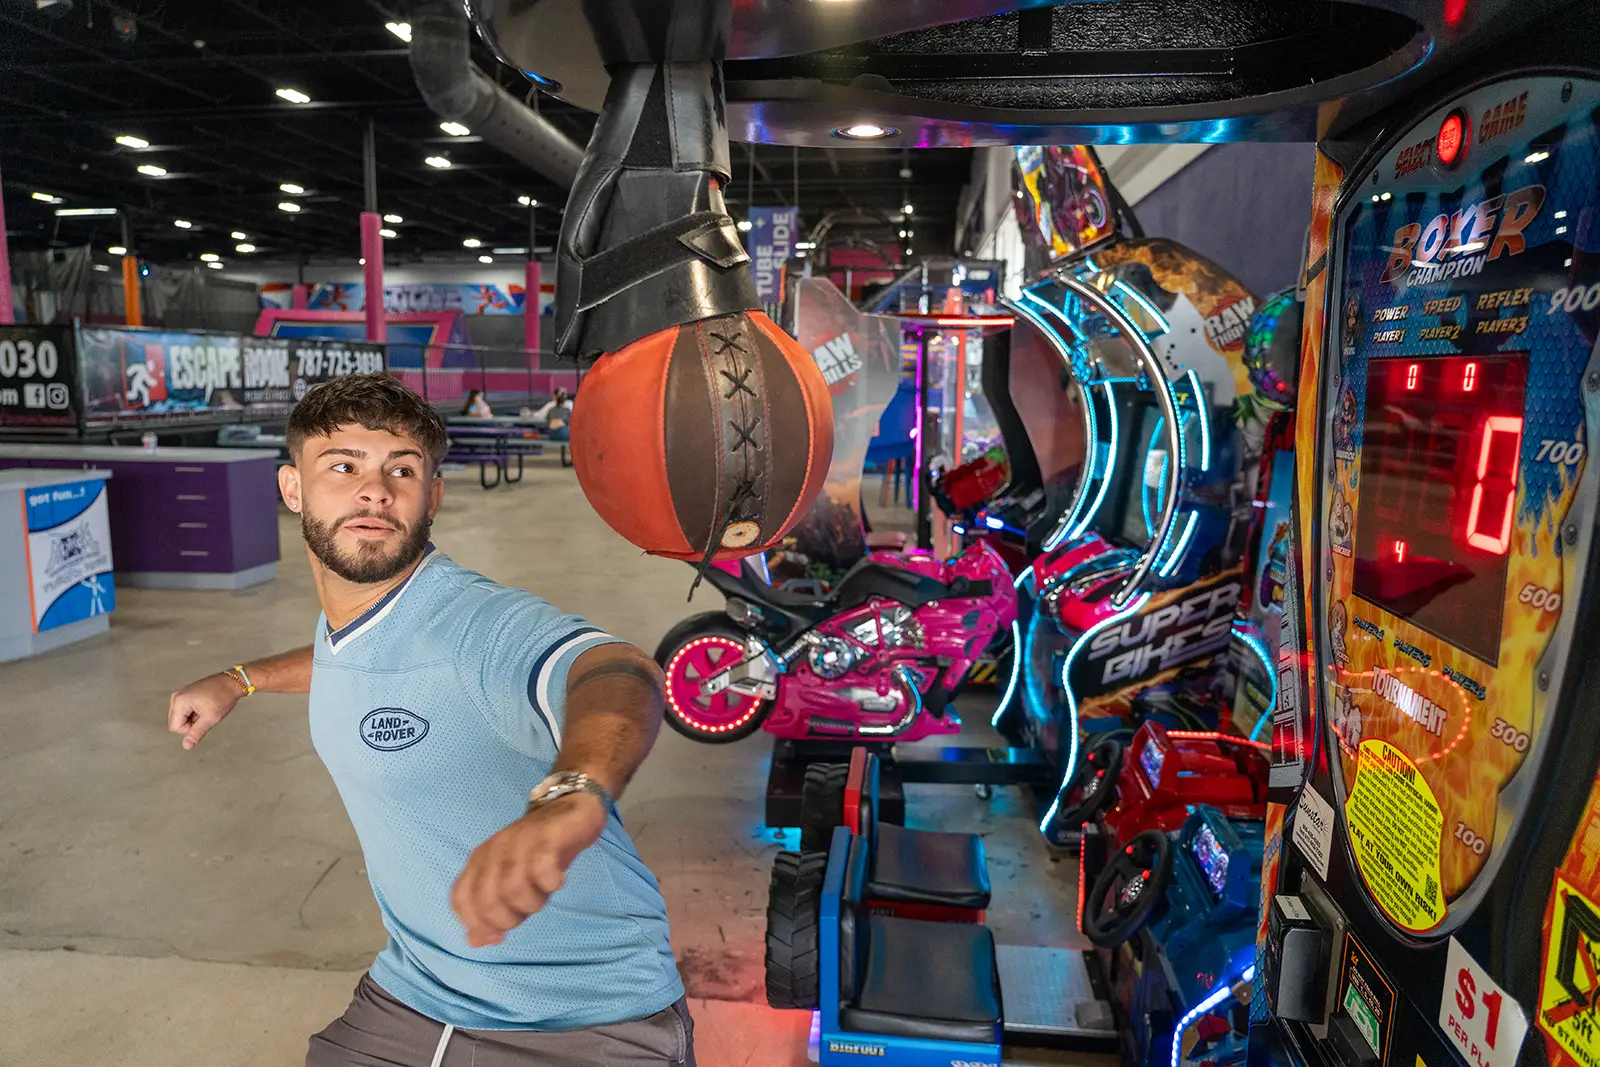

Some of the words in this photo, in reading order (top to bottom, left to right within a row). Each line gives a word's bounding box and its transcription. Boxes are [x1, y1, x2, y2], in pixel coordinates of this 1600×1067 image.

[772, 212, 790, 270] SLIDE
[1380, 184, 1546, 284] BOXER
[756, 245, 774, 297] TUBE
[1406, 255, 1488, 288] CHAMPION
[1204, 296, 1255, 338] RAW
[1372, 305, 1410, 323] POWER
[1423, 296, 1462, 315] SPEED
[1475, 287, 1534, 310] REFLEX
[1547, 284, 1600, 316] 900
[1372, 329, 1406, 343] PLAYER1
[1419, 325, 1462, 341] PLAYER2
[1475, 316, 1529, 334] PLAYER3
[812, 332, 854, 370] AW
[170, 345, 242, 394] ESCAPE
[244, 348, 290, 388] ROOM
[1407, 364, 1418, 390] 0
[1463, 363, 1476, 391] 0
[1535, 440, 1584, 465] 700
[1466, 416, 1523, 555] 0
[1395, 540, 1406, 562] 4
[1519, 584, 1561, 612] 500
[1088, 582, 1241, 660] SUPER
[1353, 615, 1384, 642] PLAYER4
[1101, 613, 1235, 685] BIKES
[1371, 665, 1447, 737] TOURNAMENT
[371, 717, 401, 729] LAND
[375, 727, 415, 742] ROVER
[1491, 718, 1529, 751] 300
[1382, 744, 1416, 786] CAUTION!
[1454, 821, 1486, 854] 100
[1349, 820, 1365, 842] PLAY
[1366, 839, 1374, 853] AT
[1375, 848, 1395, 876] YOUR
[1395, 871, 1414, 897] OWN
[1414, 891, 1437, 923] RISK!
[1454, 966, 1502, 1052] $1
[1572, 1010, 1593, 1044] 5ft
[1448, 1013, 1469, 1049] PER
